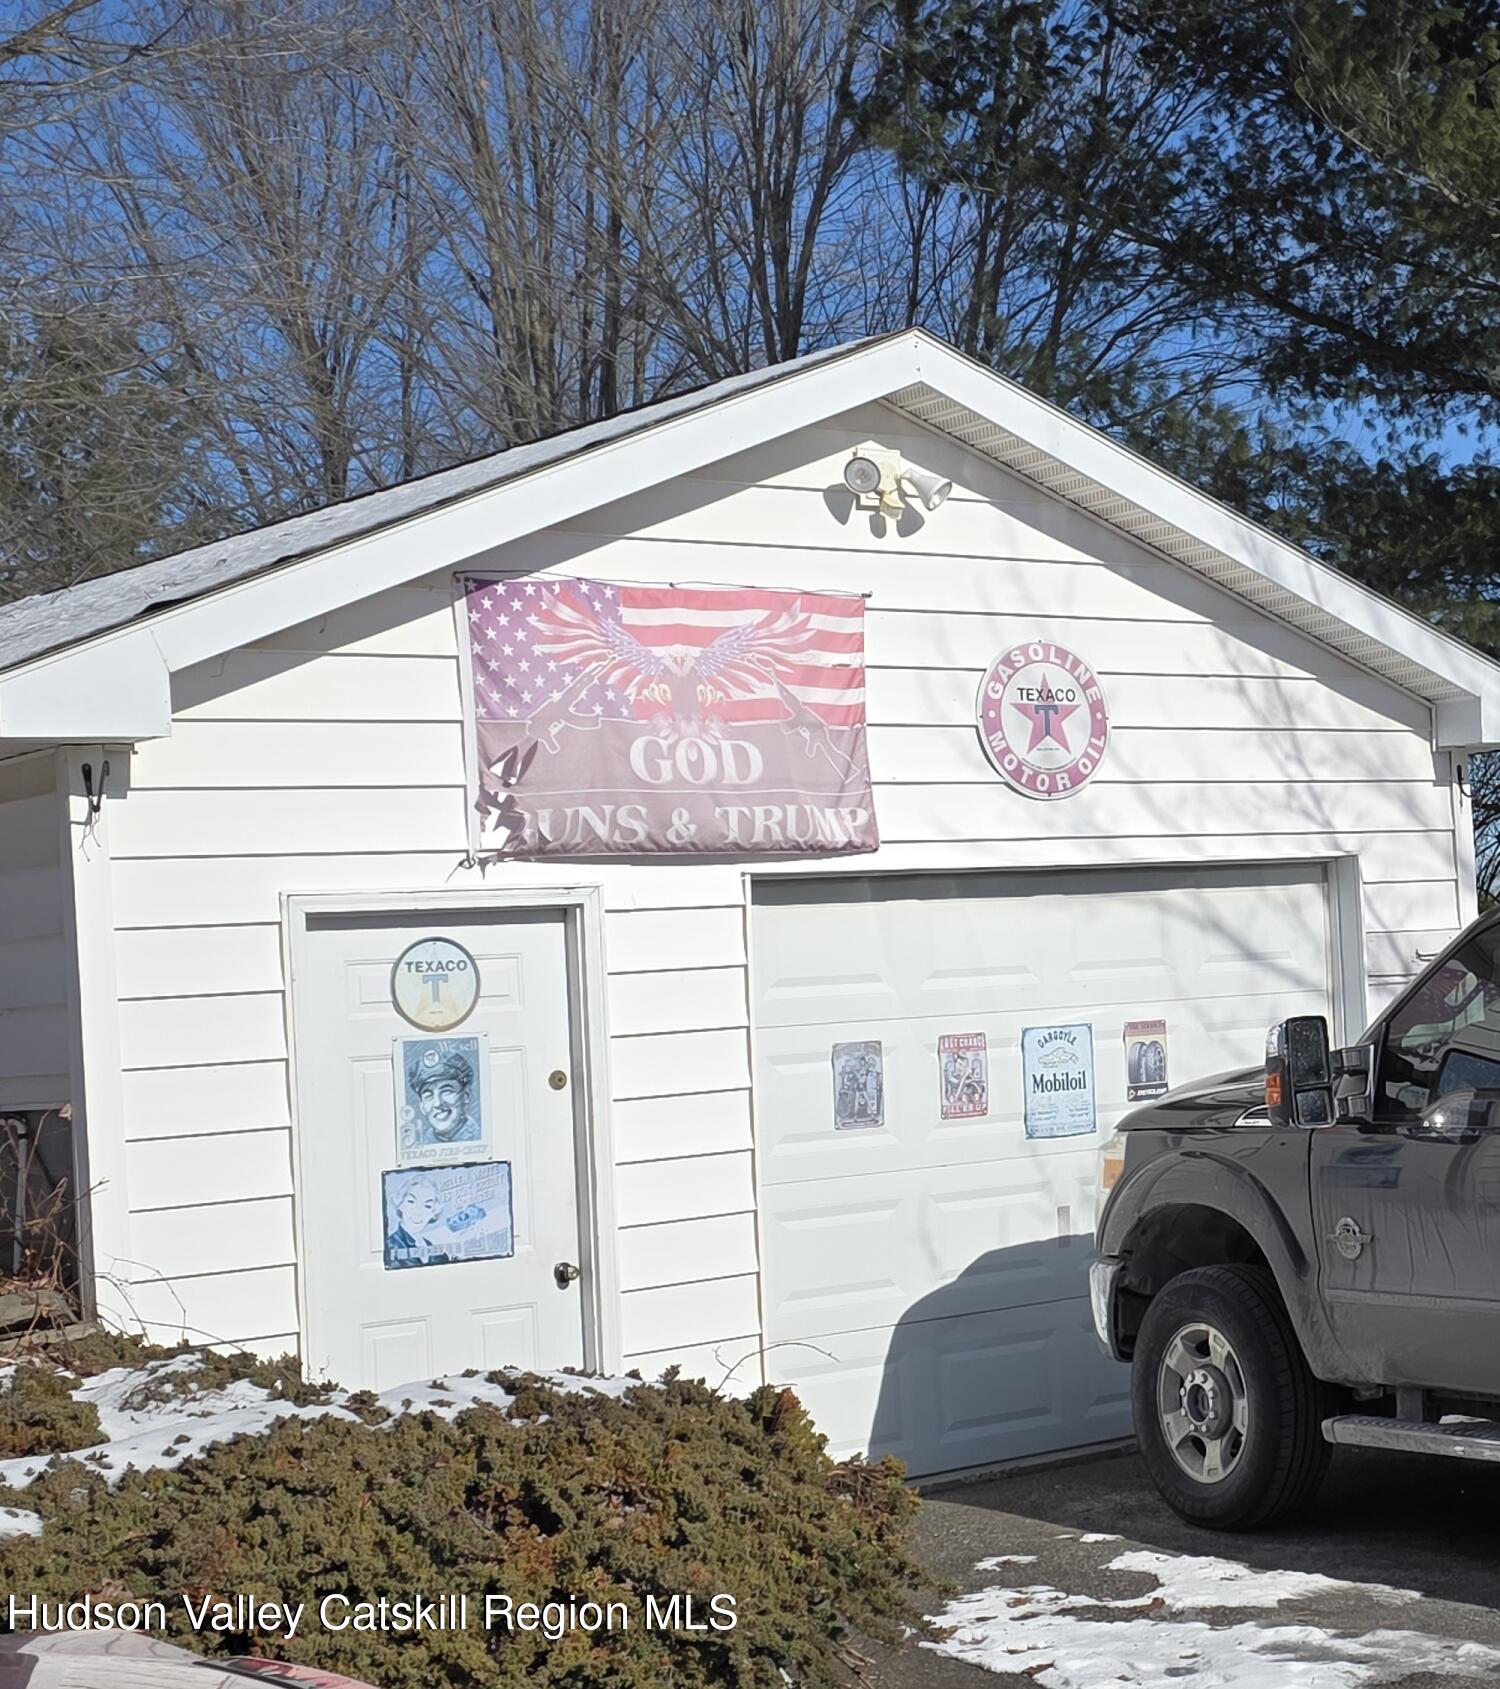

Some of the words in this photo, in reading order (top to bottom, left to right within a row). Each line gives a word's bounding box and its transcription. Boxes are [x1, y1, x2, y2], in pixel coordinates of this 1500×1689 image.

[987, 643, 1101, 704] GASOLINE
[1017, 687, 1076, 702] TEXACO
[629, 735, 764, 785] GOD
[988, 730, 1072, 791] MOTOR
[1077, 735, 1105, 775] OIL
[523, 804, 649, 846] UNS
[666, 807, 697, 844] &
[715, 804, 870, 843] TRUMP
[404, 959, 468, 973] TEXACO
[1037, 1030, 1077, 1048] GARGOYLE
[1032, 1070, 1087, 1094] Mobiloil
